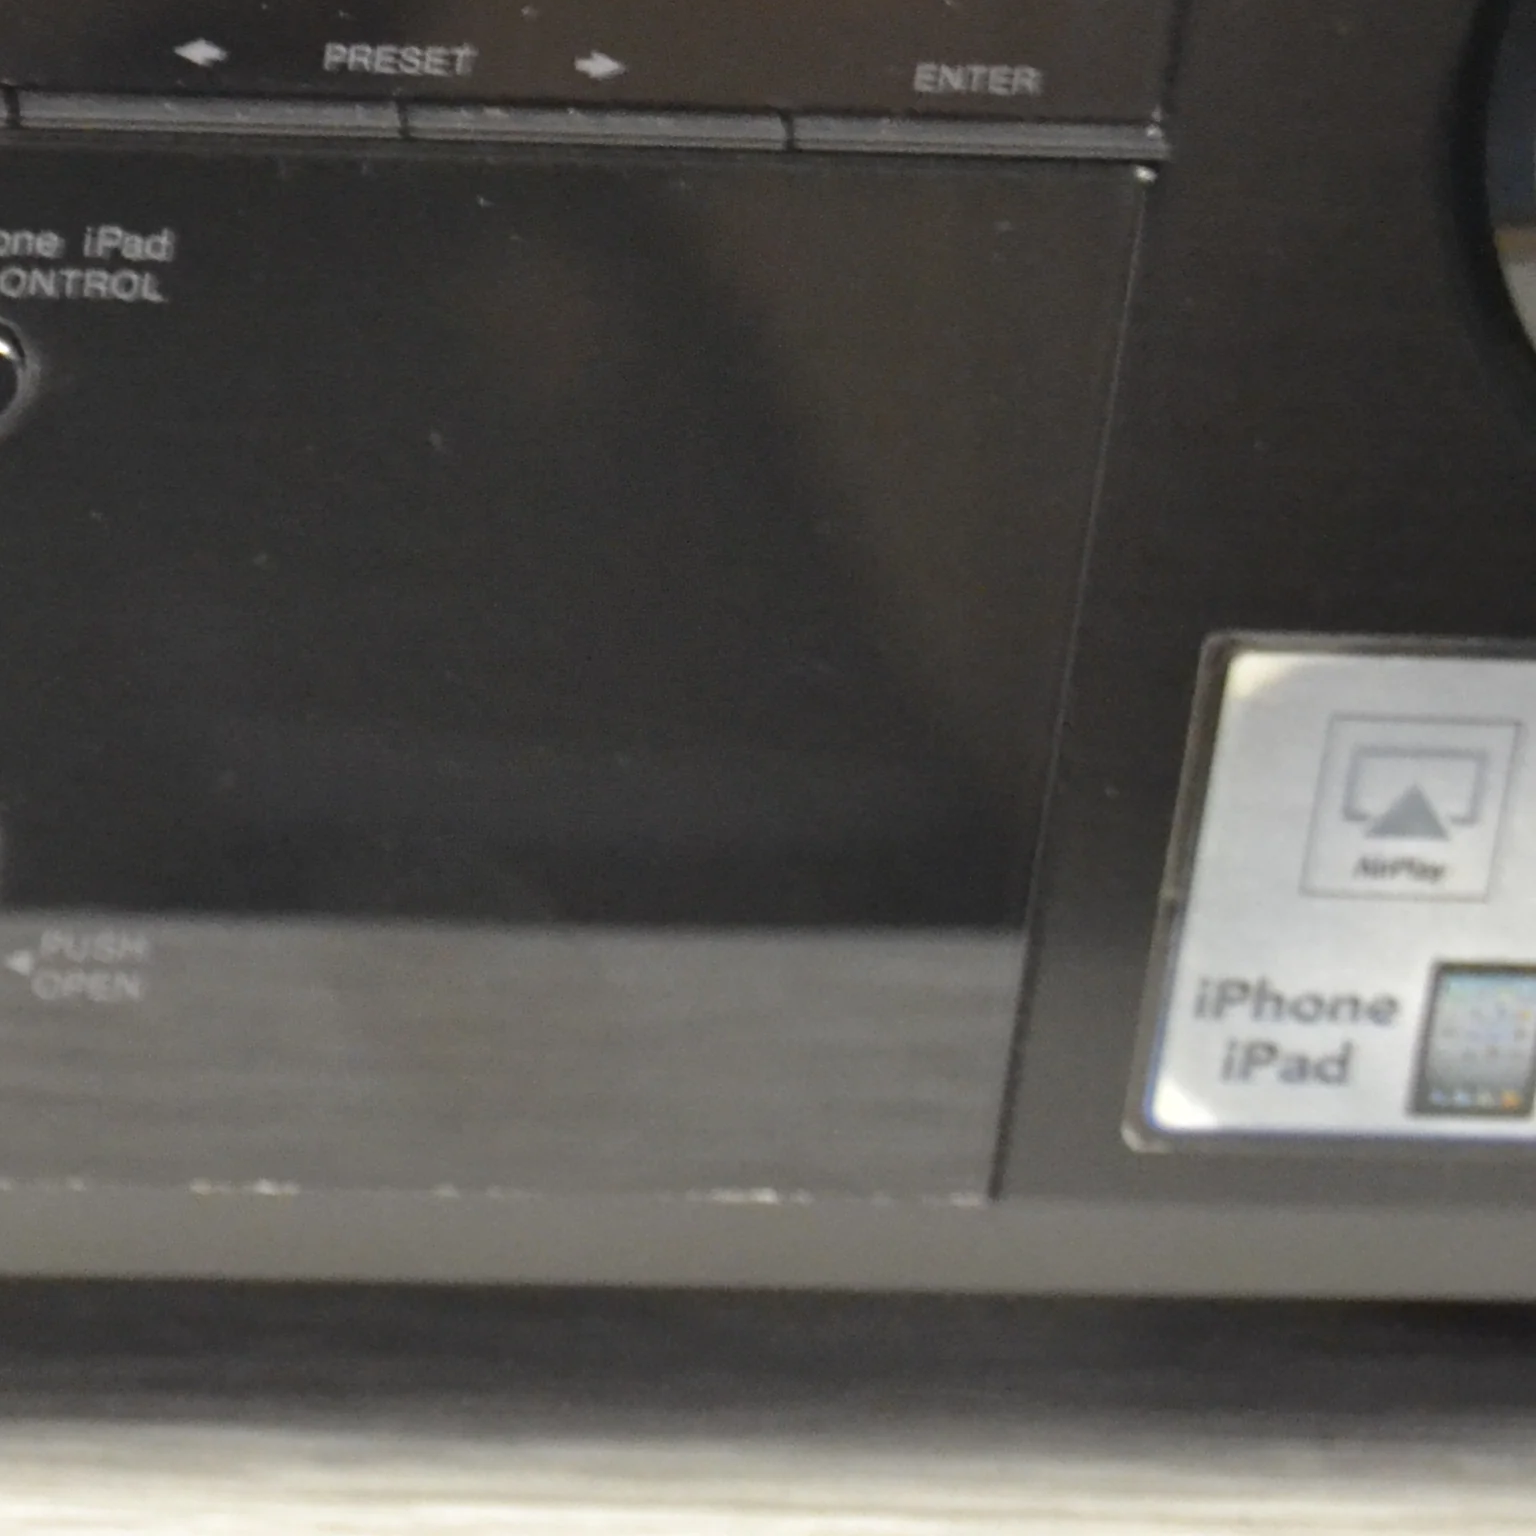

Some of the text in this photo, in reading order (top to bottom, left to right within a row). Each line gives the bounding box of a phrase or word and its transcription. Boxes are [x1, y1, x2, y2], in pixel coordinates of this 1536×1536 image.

[323, 41, 477, 77] PRESET
[913, 62, 1043, 96] ENTER
[83, 224, 175, 263] iPad
[40, 929, 151, 962] PUSH
[30, 969, 143, 1002] OPEN
[1194, 976, 1400, 1026] iPhone
[1221, 1040, 1353, 1087] iPad
